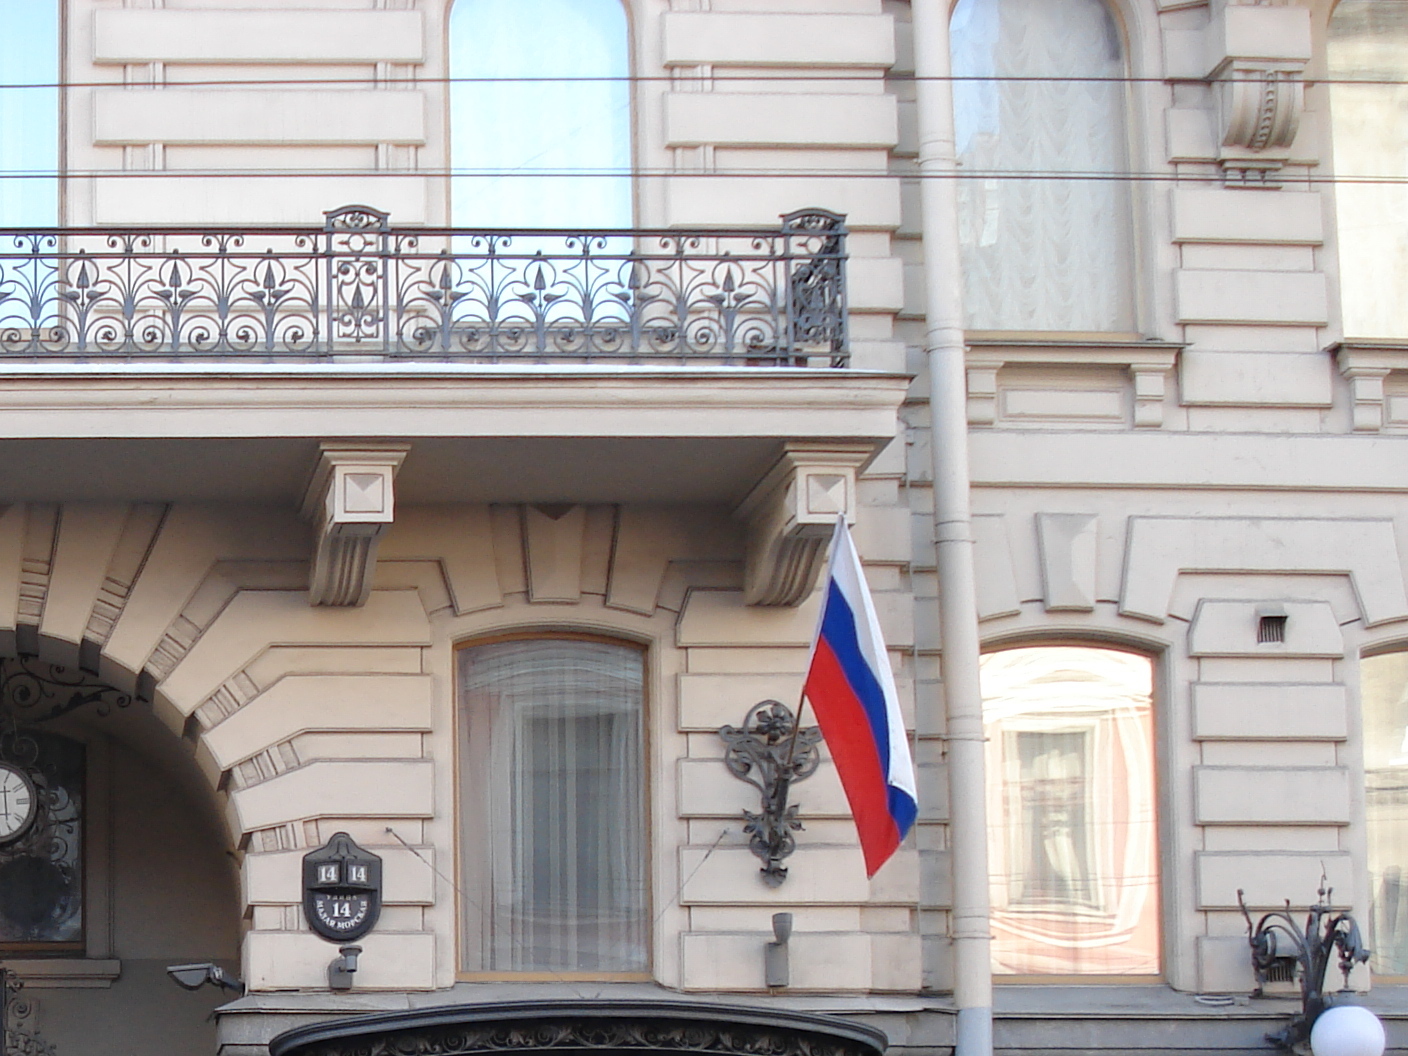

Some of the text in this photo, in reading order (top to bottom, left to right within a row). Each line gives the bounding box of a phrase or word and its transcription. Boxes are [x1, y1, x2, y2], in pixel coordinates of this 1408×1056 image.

[320, 866, 337, 882] 14
[351, 866, 366, 882] 14
[332, 902, 351, 918] 14
